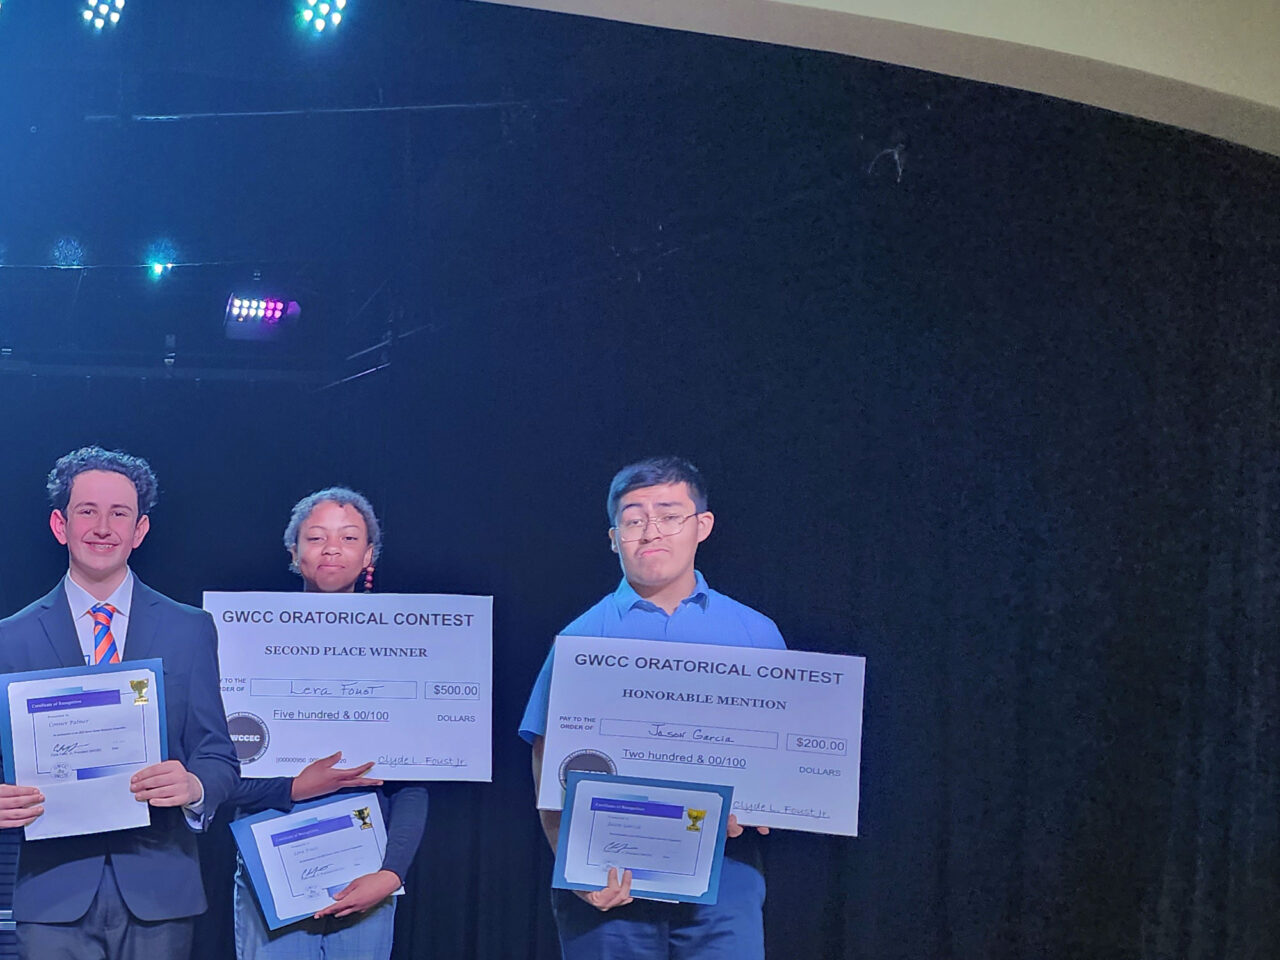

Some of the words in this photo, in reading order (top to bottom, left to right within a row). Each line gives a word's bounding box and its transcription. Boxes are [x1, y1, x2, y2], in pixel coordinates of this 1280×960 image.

[222, 610, 274, 623] GWCC
[280, 611, 389, 625] ORATORICAL
[394, 612, 474, 627] CONTEST
[264, 646, 320, 656] SECOND
[324, 646, 367, 656] PLACE
[370, 648, 428, 658] WINNER
[574, 653, 630, 668] GWCC
[635, 656, 751, 677] ORATORICAL
[757, 666, 844, 685] CONTEST
[290, 680, 332, 696] Lera
[434, 684, 478, 696] $500.00
[622, 688, 714, 704] HONORABLE
[717, 695, 788, 710] MENTION
[274, 710, 295, 720] Five
[298, 710, 340, 720] hundred
[344, 710, 350, 720] &
[354, 710, 389, 721] 00/100
[437, 715, 476, 723] DOLLARS
[796, 736, 845, 751] $200.00
[378, 754, 409, 768] Clyde
[426, 756, 453, 766] Foust
[622, 748, 645, 759] Two
[648, 750, 693, 763] hundred
[696, 754, 704, 764] &
[708, 756, 747, 768] 00/100
[799, 766, 841, 777] DOLLARS
[732, 800, 766, 814] Clyde
[784, 806, 815, 816] Foust
